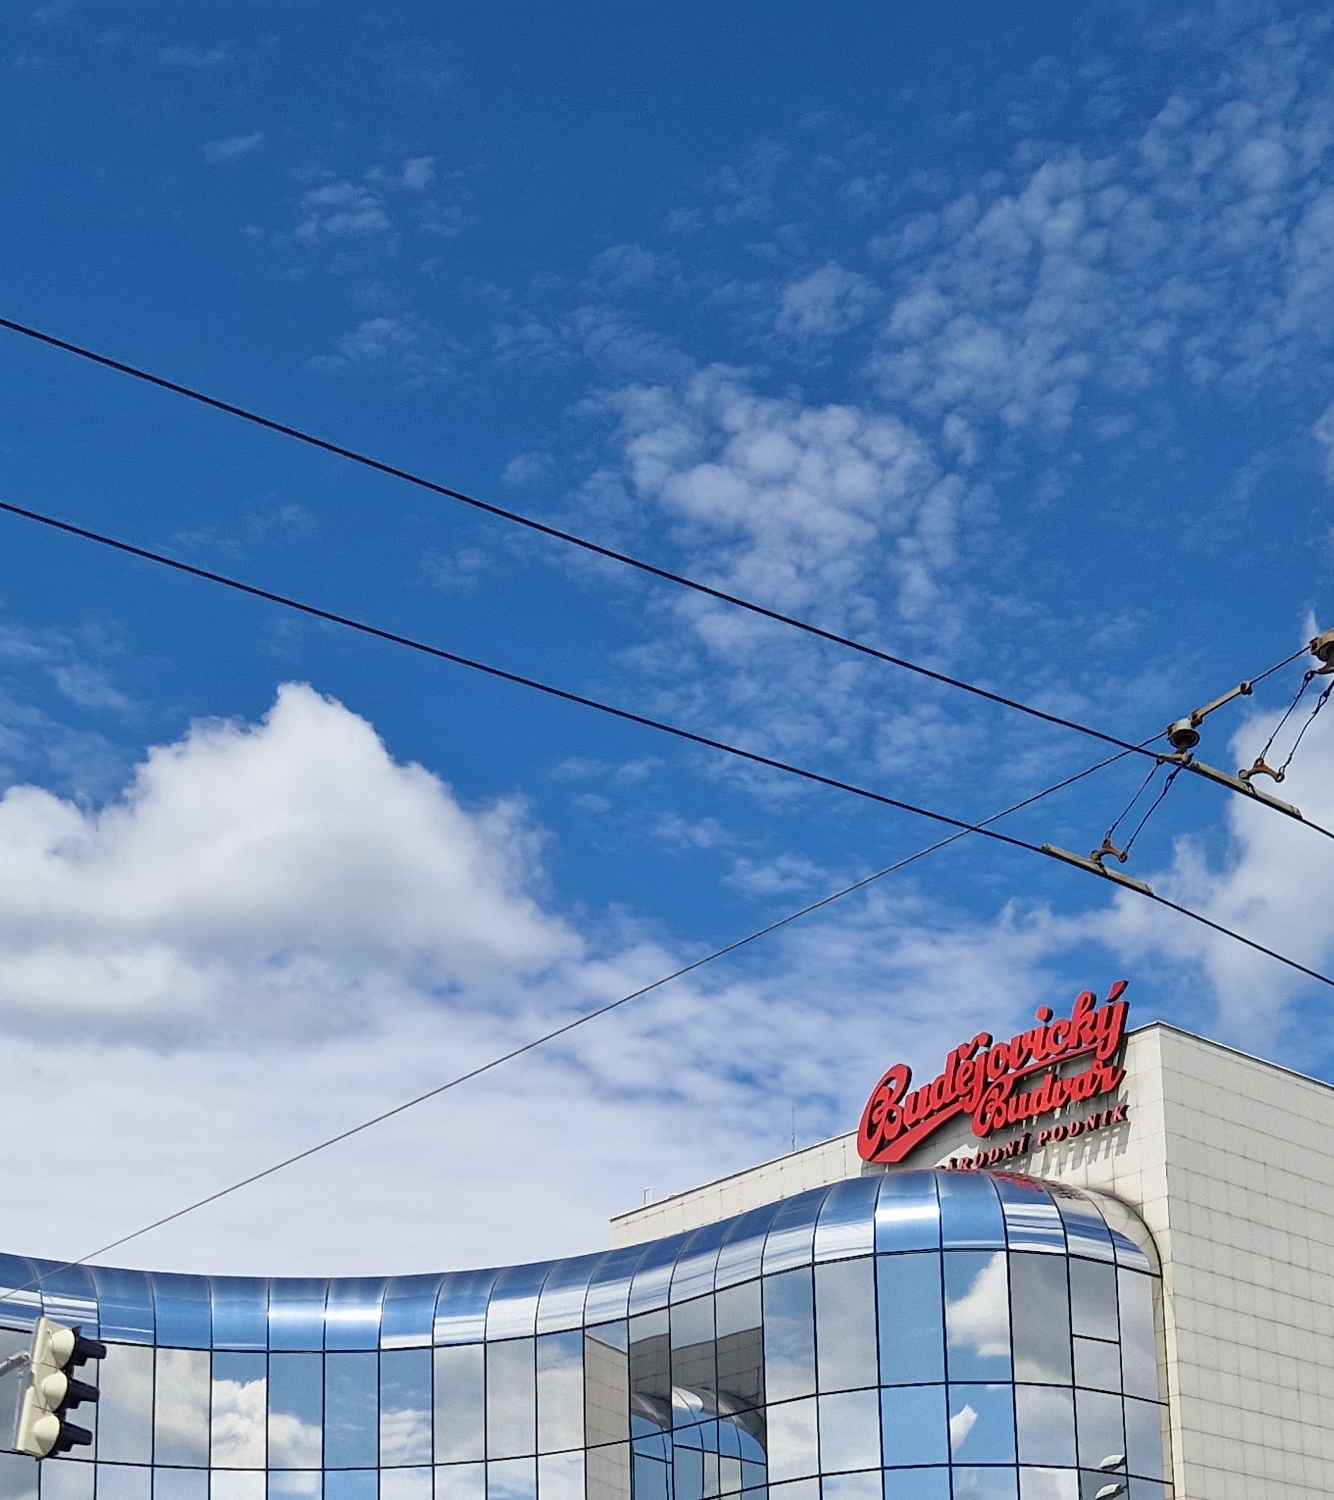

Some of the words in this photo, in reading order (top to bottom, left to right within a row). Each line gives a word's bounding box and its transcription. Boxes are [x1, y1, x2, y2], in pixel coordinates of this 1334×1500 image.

[856, 979, 1130, 1164] Budějovický
[971, 1058, 1128, 1138] Budvar
[1036, 1104, 1130, 1148] PODNIK
